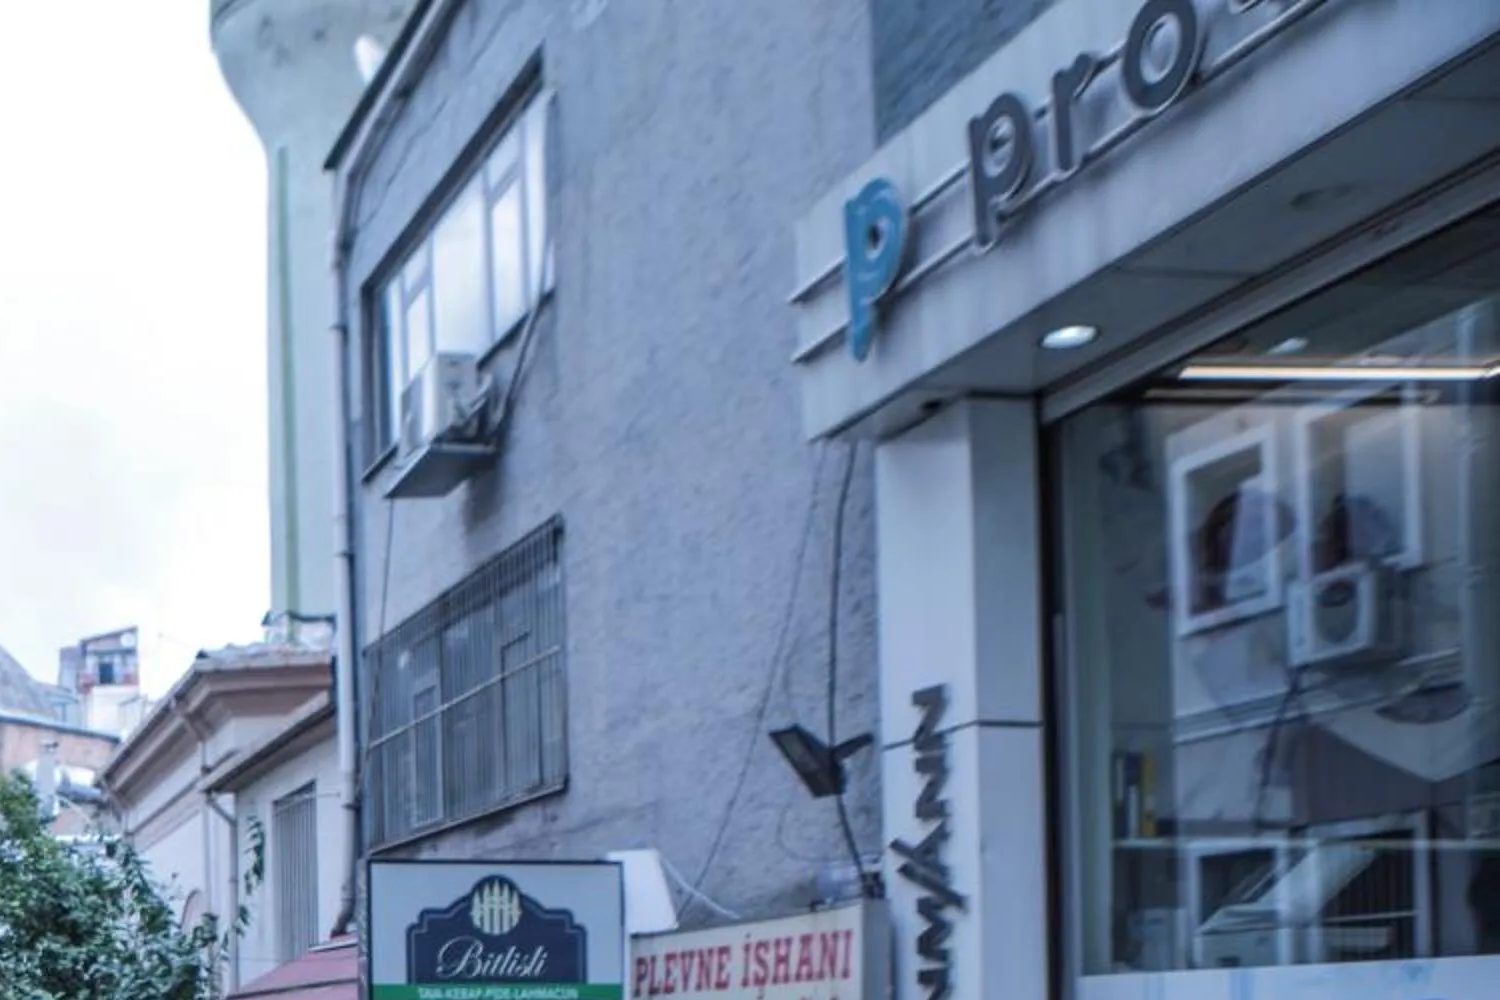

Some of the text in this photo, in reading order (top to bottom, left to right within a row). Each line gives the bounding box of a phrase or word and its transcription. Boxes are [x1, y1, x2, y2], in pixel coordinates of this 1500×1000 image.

[965, 0, 1262, 252] pro
[435, 936, 549, 979] Bitlisli
[633, 945, 732, 998] PLEVNE
